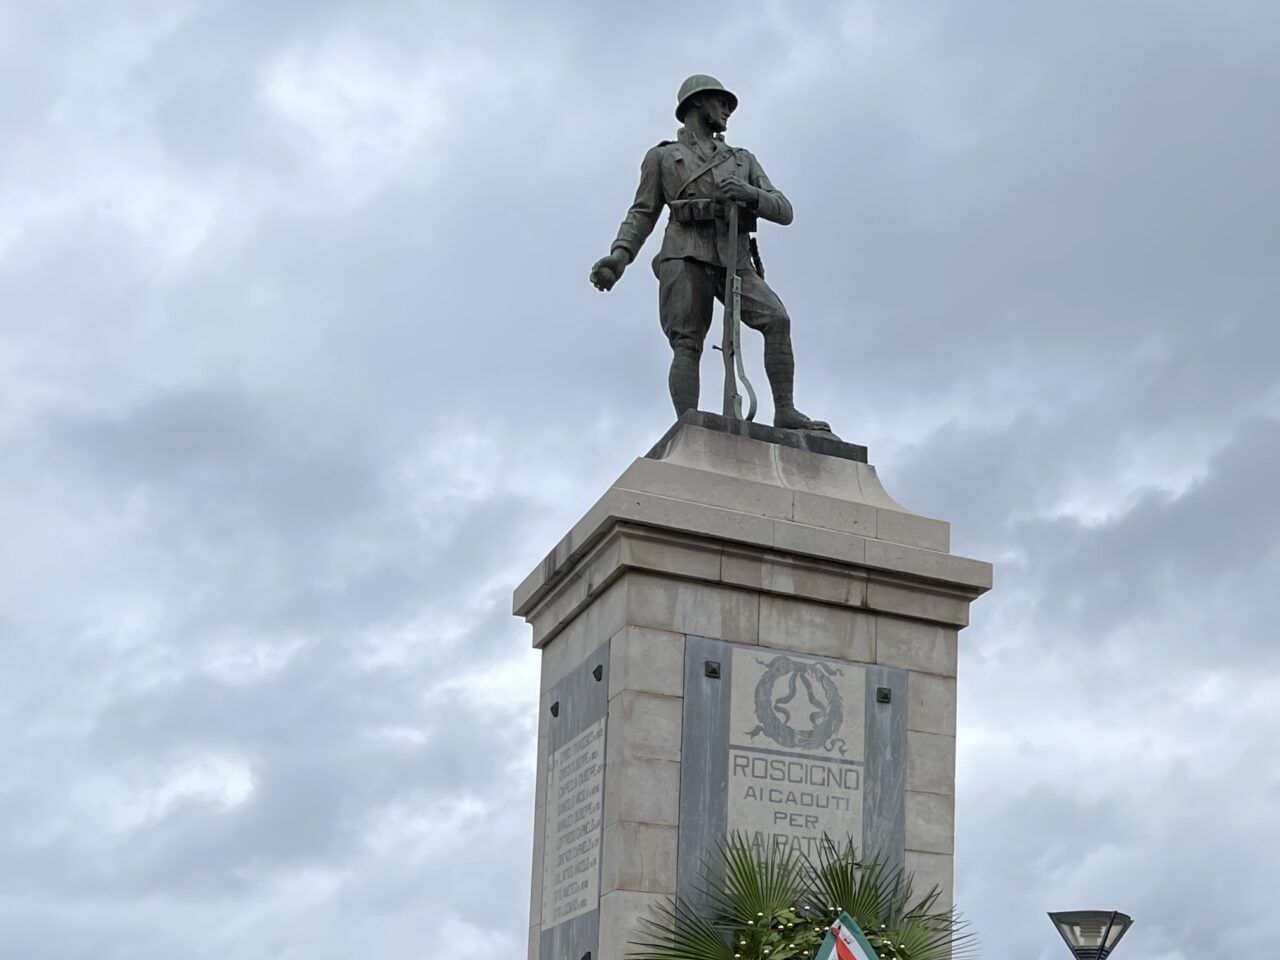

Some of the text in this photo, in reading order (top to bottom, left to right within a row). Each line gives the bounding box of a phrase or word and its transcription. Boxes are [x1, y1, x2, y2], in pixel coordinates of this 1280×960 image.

[733, 754, 859, 790] ROSCIGNO
[744, 785, 850, 811] AI CADUTI
[773, 811, 819, 829] PER
